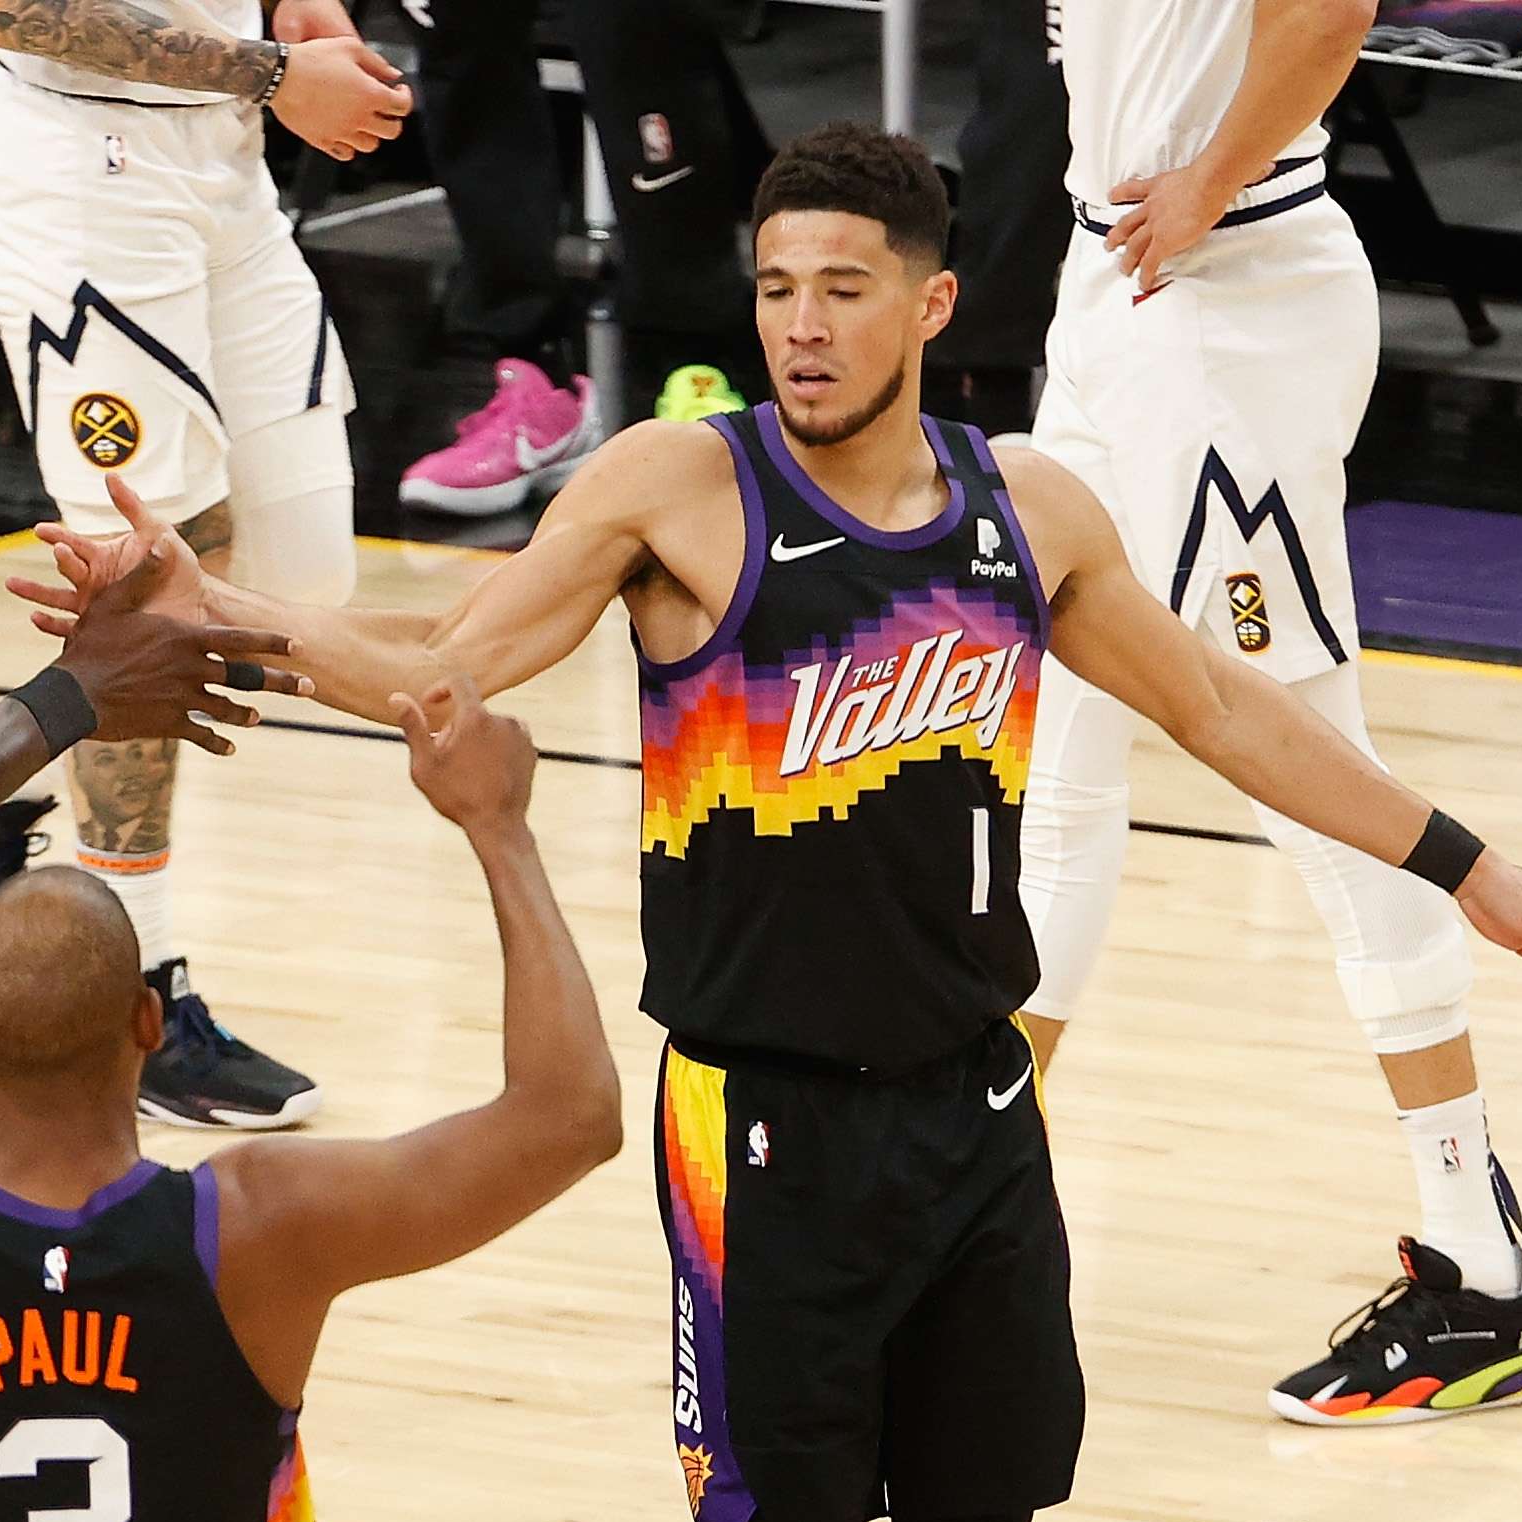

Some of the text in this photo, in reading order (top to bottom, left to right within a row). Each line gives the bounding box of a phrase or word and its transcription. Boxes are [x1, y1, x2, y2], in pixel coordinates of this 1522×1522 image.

[971, 559, 1017, 579] PayPal
[779, 628, 1024, 777] Valley
[852, 654, 901, 688] THE
[971, 807, 991, 915] 1
